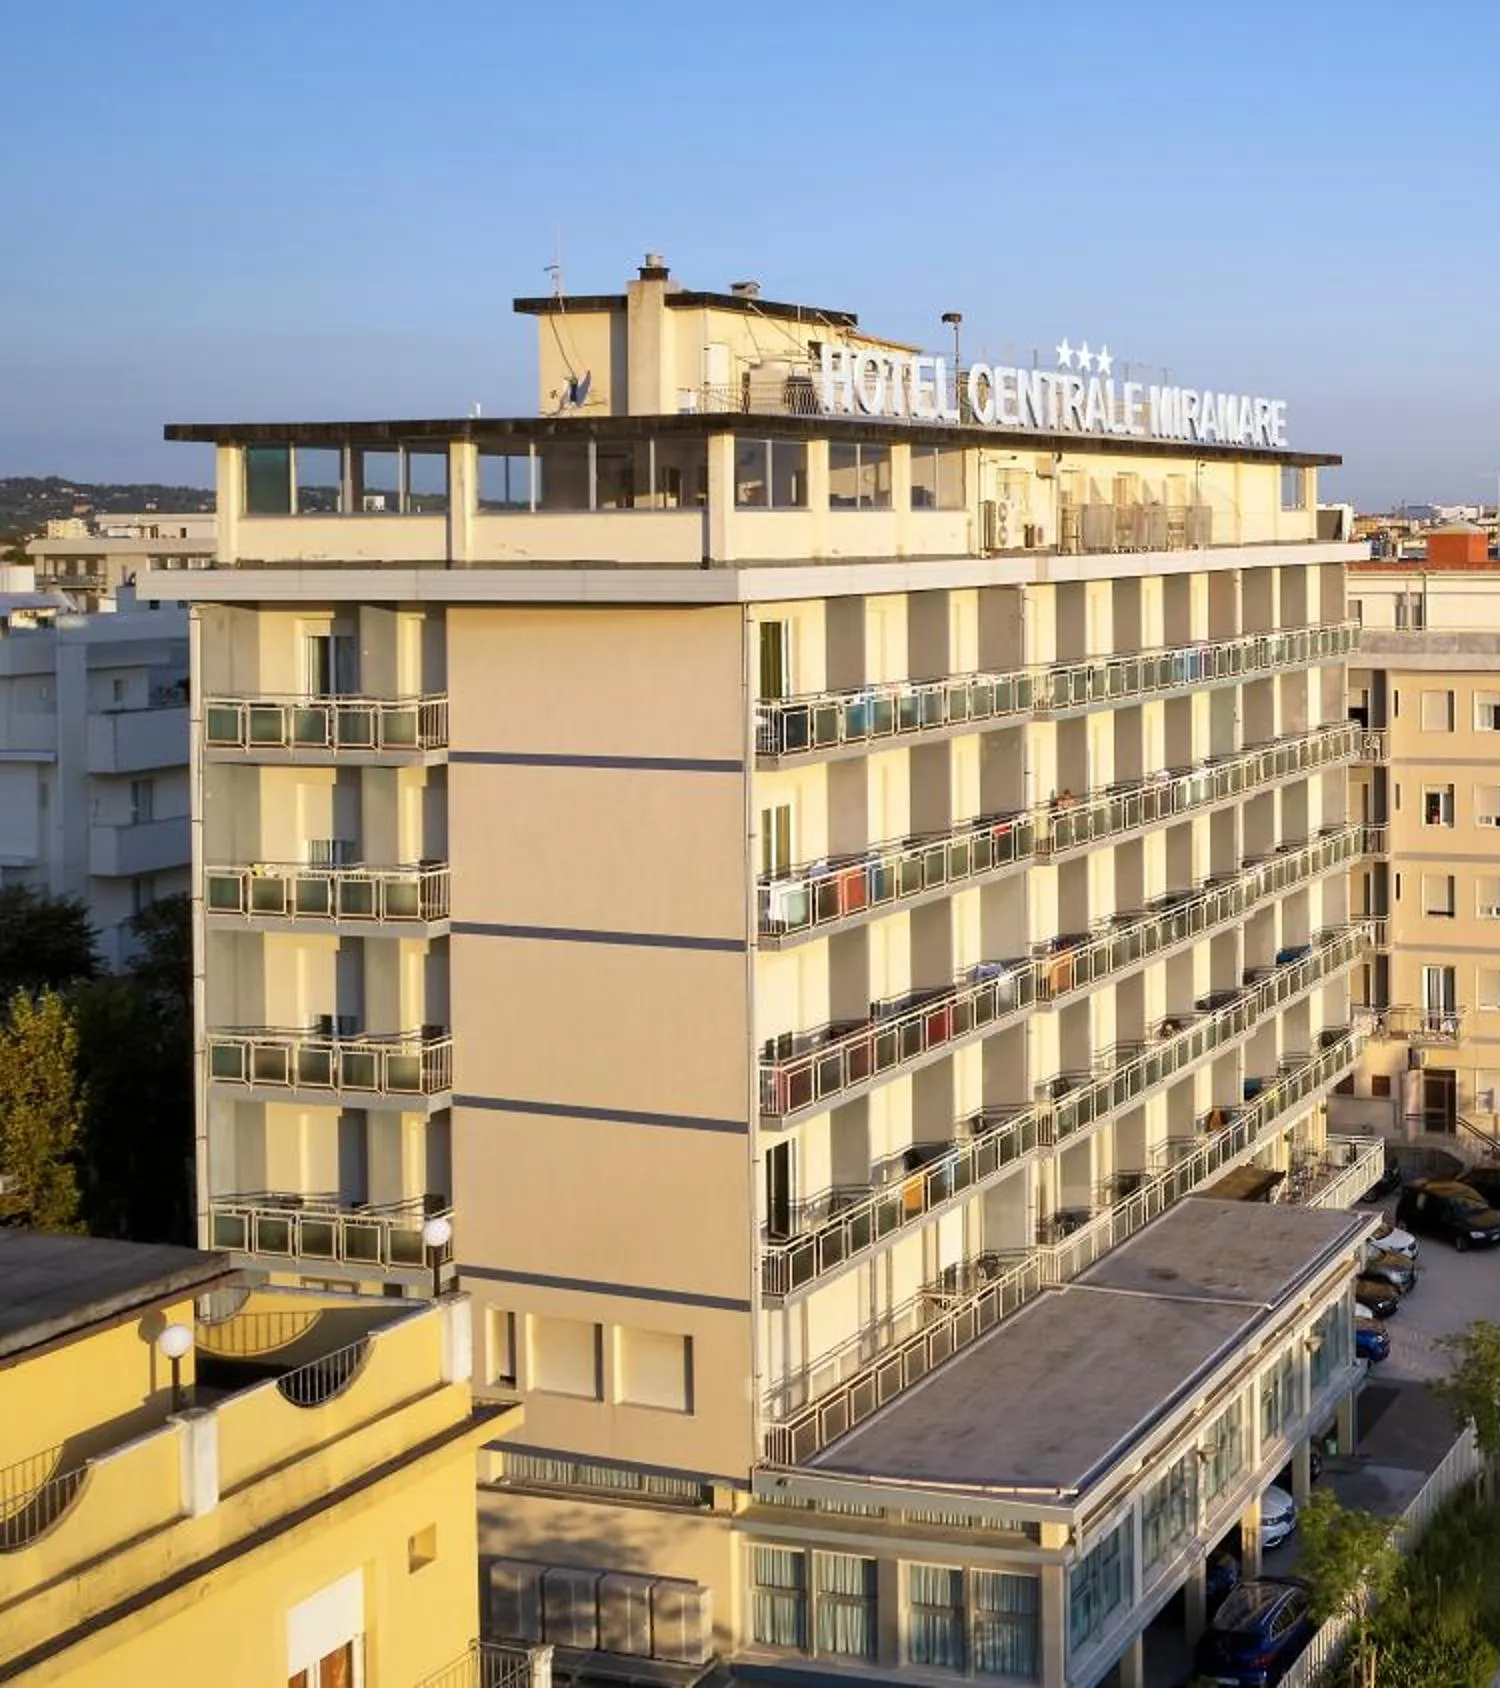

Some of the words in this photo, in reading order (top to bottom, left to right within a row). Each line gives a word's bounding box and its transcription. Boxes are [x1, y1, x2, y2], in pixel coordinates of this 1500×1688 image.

[820, 342, 958, 423] HOTEL
[968, 362, 1144, 434] CENTRALE
[1150, 385, 1287, 446] MIRAMARE
